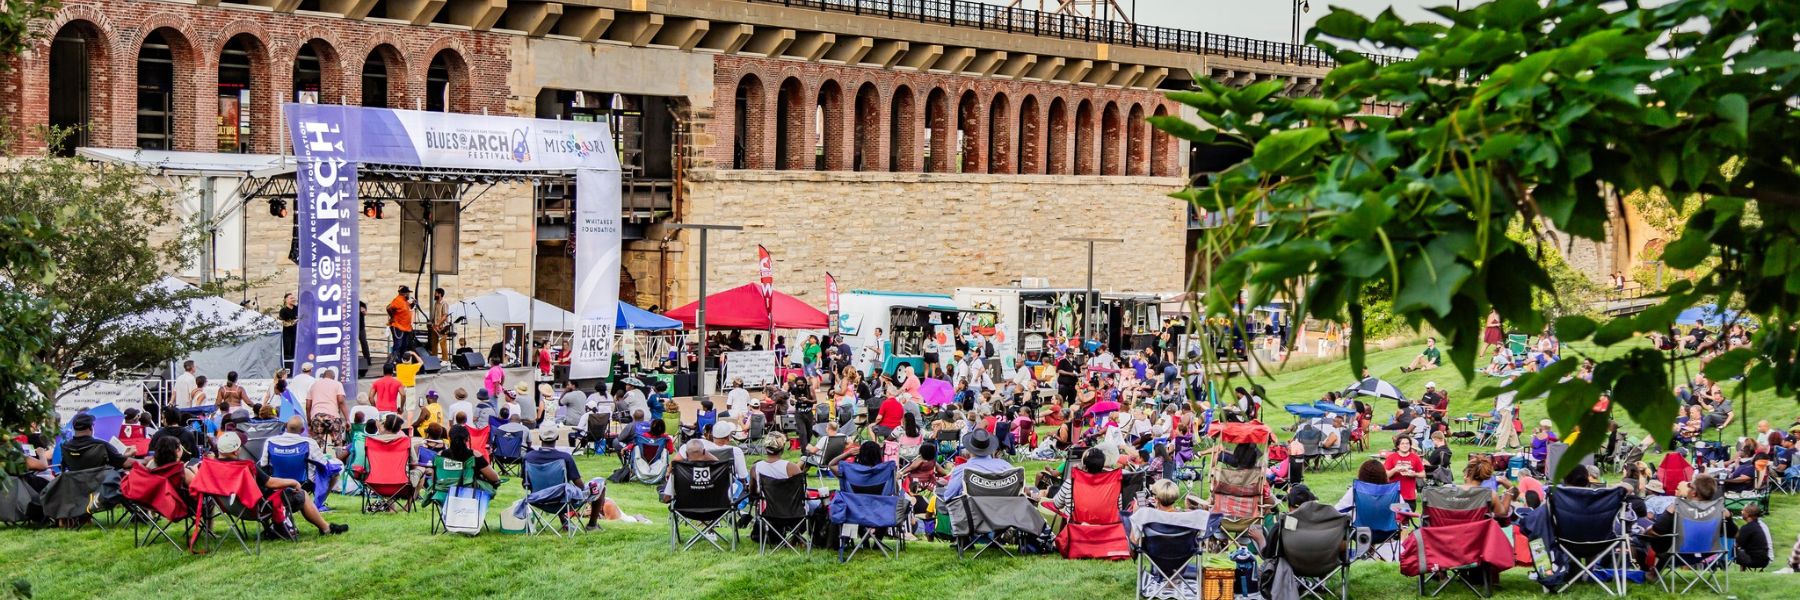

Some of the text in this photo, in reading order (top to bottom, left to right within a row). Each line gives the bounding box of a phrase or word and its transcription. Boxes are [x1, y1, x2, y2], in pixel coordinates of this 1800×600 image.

[299, 121, 315, 184] FOUNDATION
[425, 130, 459, 150] BLUES
[468, 134, 509, 153] ARCH
[468, 151, 510, 161] FESTIVAL
[305, 122, 341, 254] ARCH
[308, 185, 316, 210] PARK
[330, 122, 352, 255] FESTIVAL
[346, 320, 352, 332] BY
[581, 338, 610, 351] ARCH
[694, 469, 709, 479] 30
